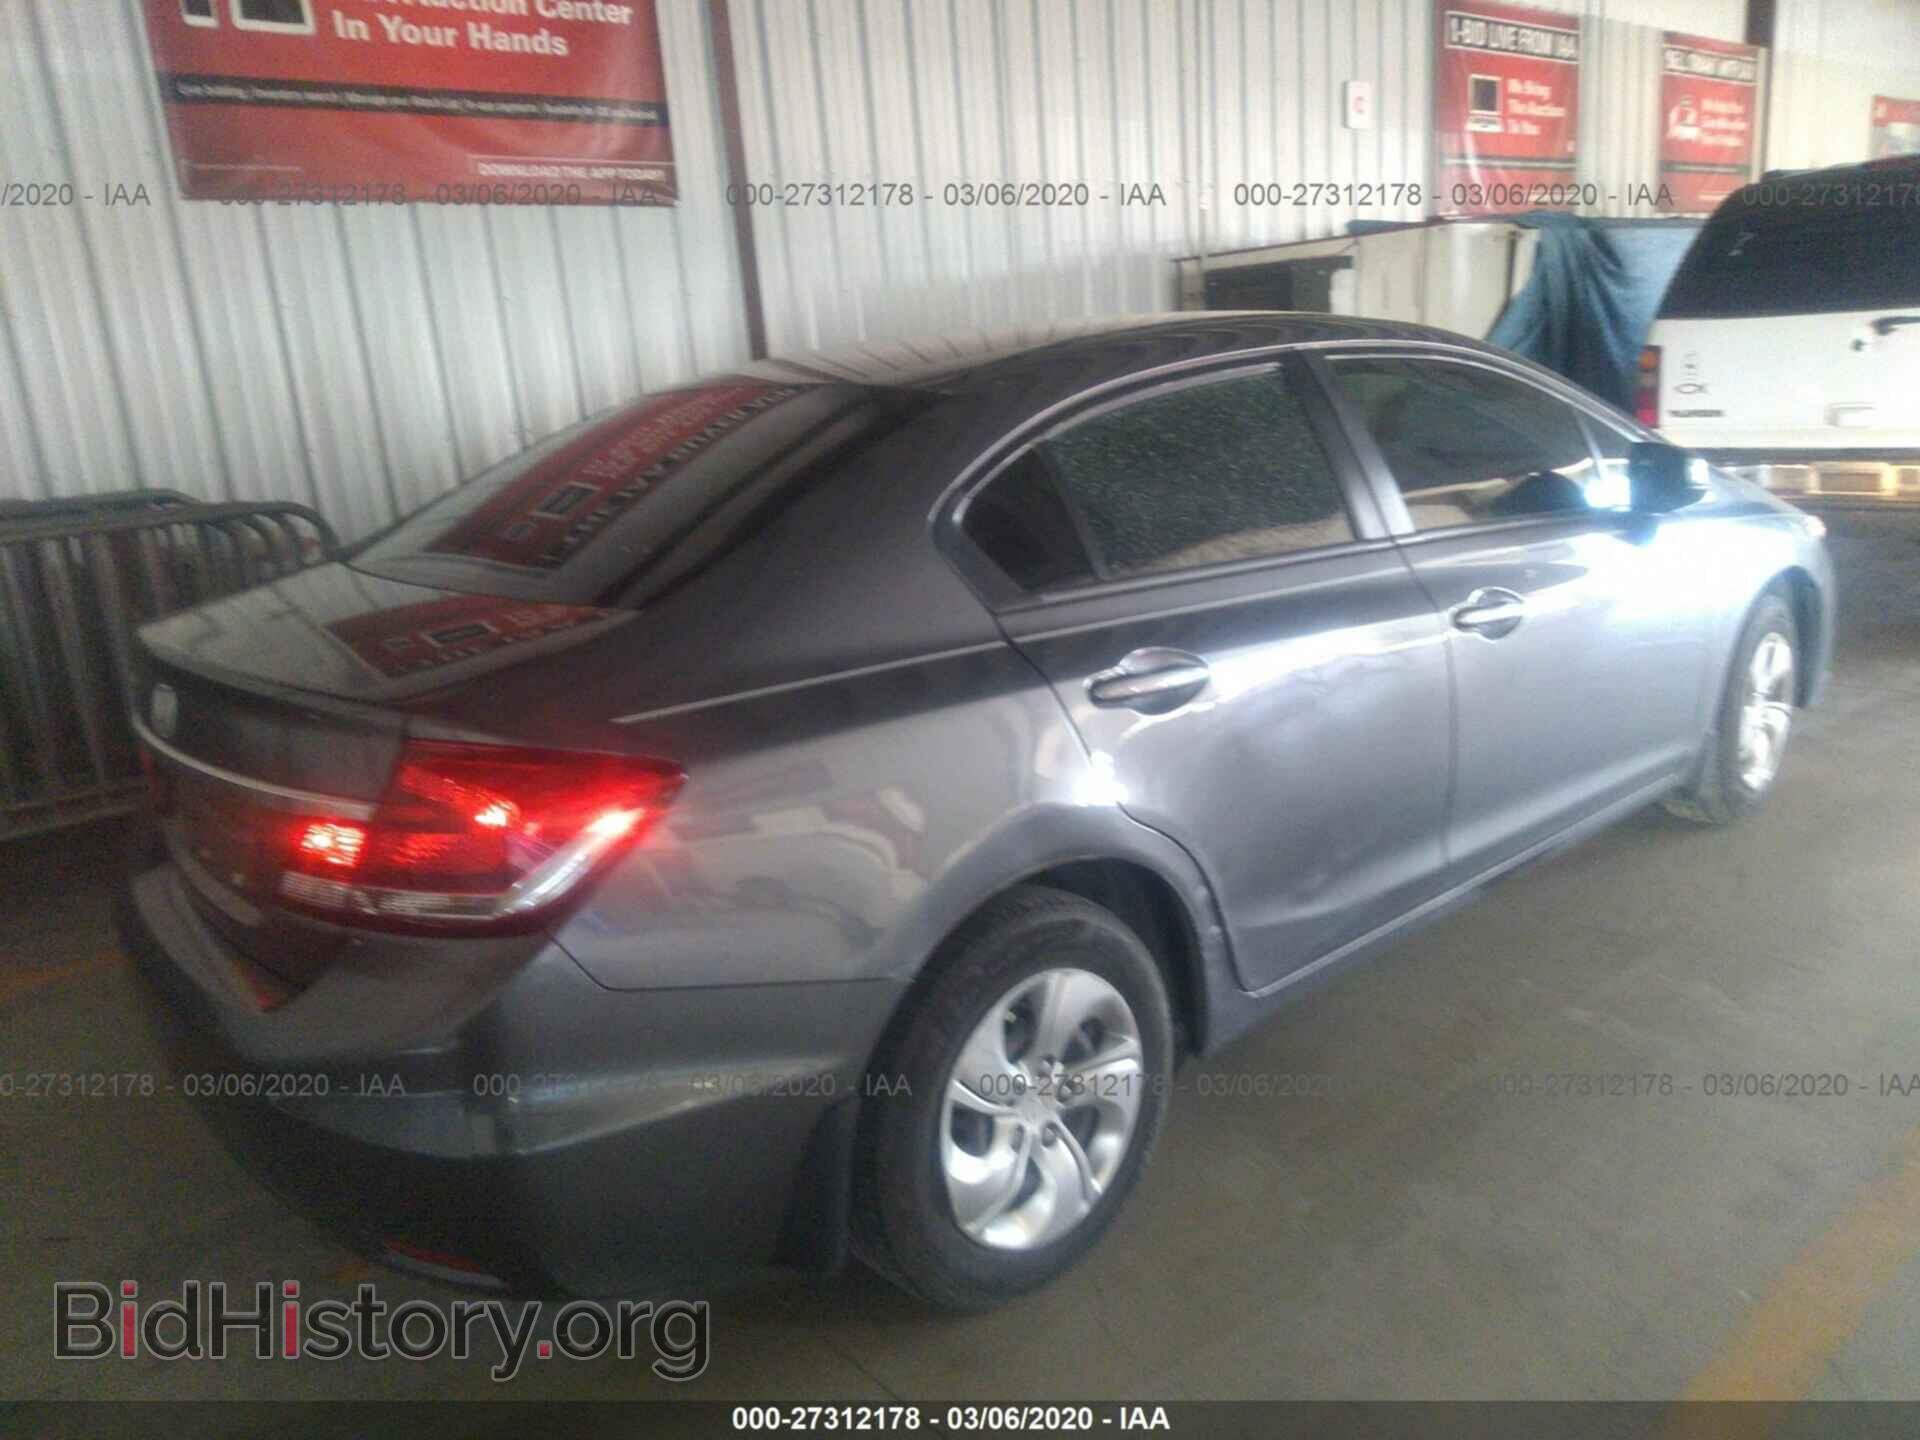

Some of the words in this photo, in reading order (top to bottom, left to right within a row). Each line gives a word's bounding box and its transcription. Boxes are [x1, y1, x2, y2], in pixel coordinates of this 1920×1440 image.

[388, 0, 528, 16] uction
[536, 0, 634, 25] Center
[331, 9, 370, 41] In
[376, 13, 458, 49] Your
[467, 22, 568, 56] Hands
